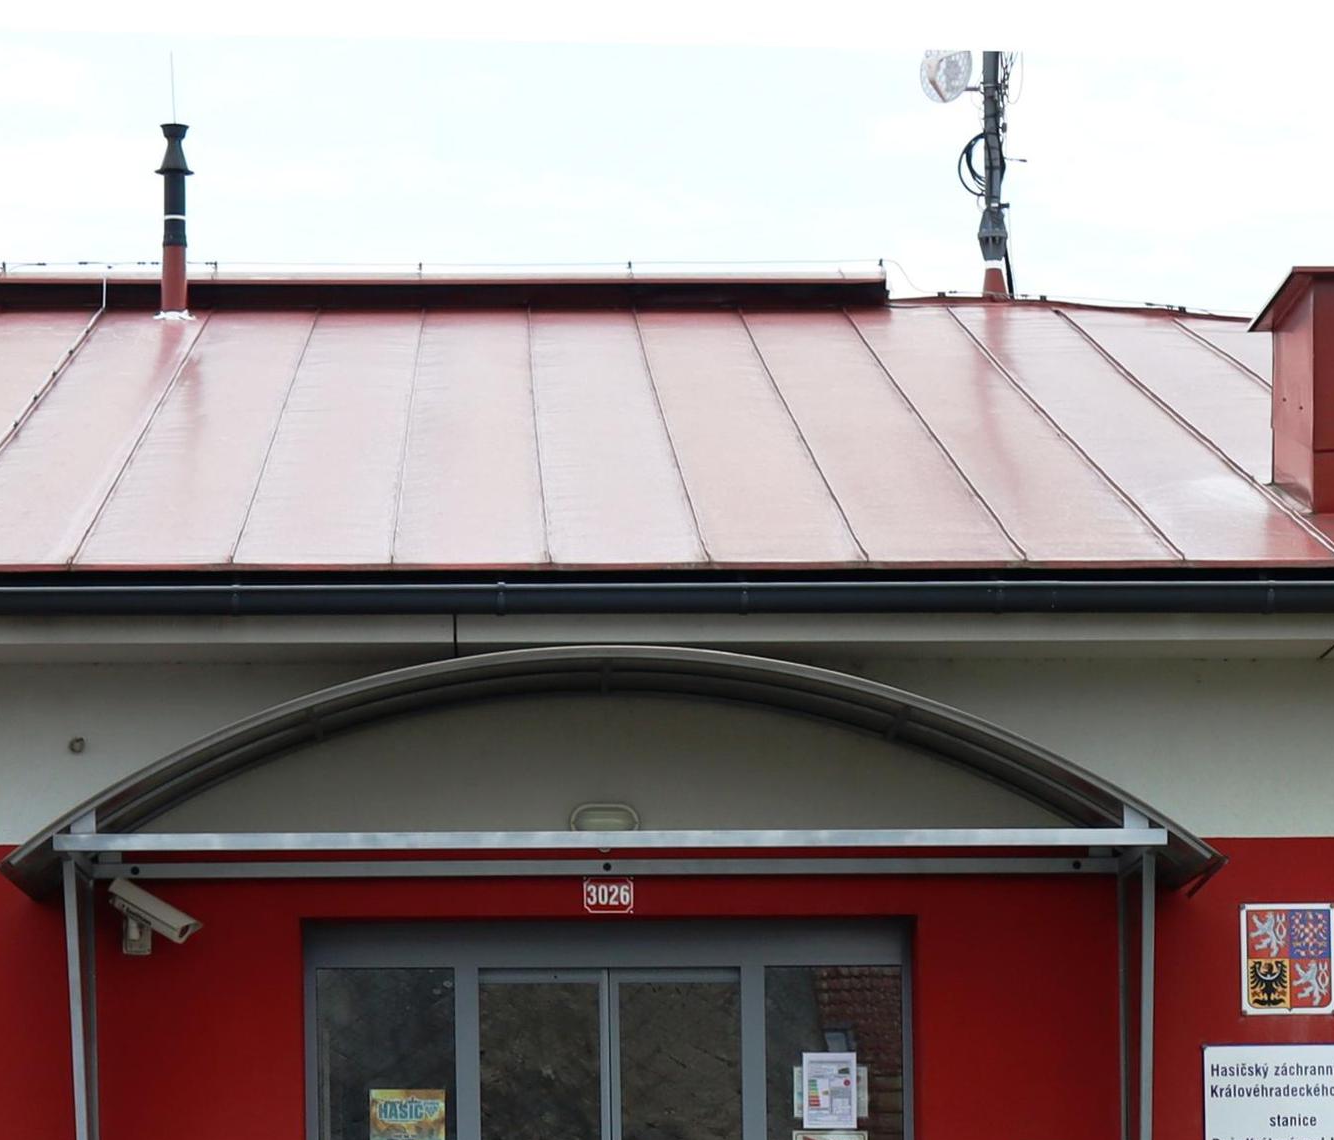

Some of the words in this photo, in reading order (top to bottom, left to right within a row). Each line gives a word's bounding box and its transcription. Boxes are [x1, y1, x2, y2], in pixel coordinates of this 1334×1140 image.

[587, 884, 630, 905] 3026
[1210, 1062, 1269, 1079] Hasičský
[1269, 1114, 1317, 1127] stanice
